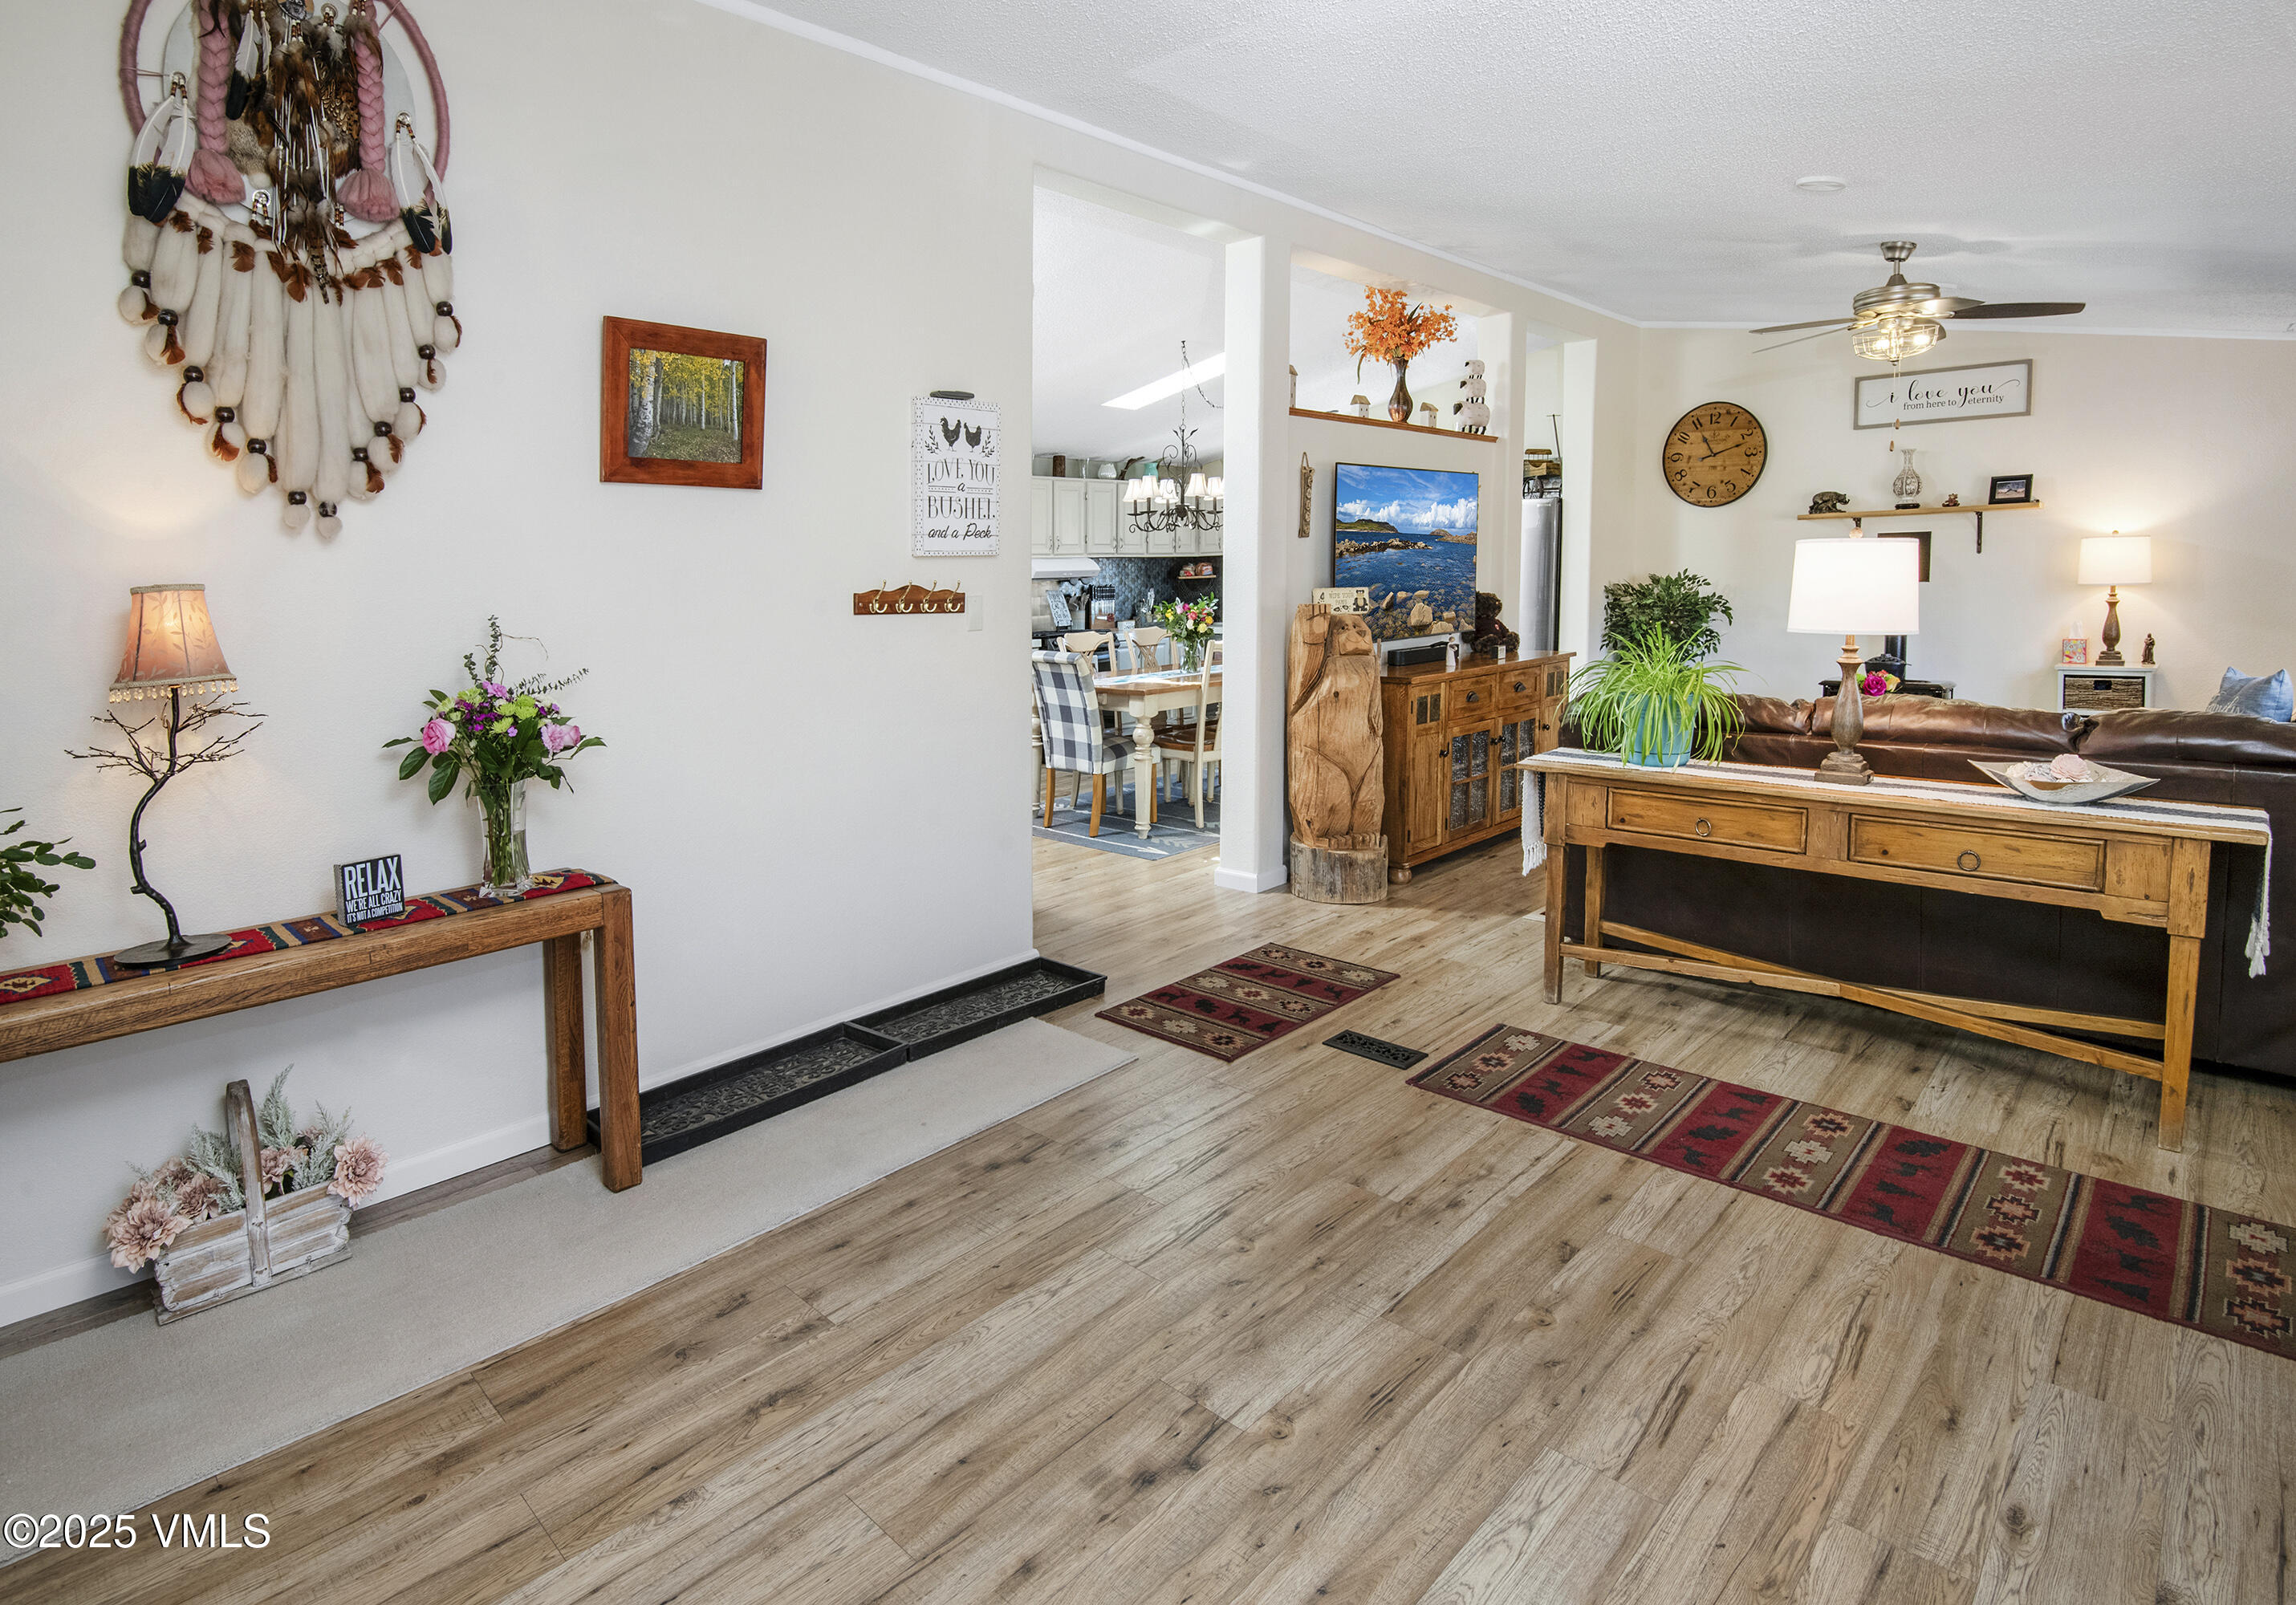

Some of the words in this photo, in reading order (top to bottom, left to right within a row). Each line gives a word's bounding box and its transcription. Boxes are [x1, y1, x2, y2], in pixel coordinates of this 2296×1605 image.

[1908, 379, 1948, 401] love
[1903, 402, 1924, 411] from
[1926, 400, 1946, 408] here
[1948, 399, 1957, 407] to
[1967, 394, 2005, 404] eternity
[1692, 417, 1703, 430] 11
[1709, 411, 1721, 425] 12
[1729, 416, 1738, 427] 1
[1677, 431, 1691, 445] 10
[1740, 429, 1753, 440] 2
[1670, 452, 1684, 463] 9
[1744, 447, 1758, 457] 3
[927, 457, 964, 484] LOVE
[969, 459, 995, 486] YOU
[1674, 469, 1688, 482] 8
[1740, 468, 1751, 479] 4
[957, 482, 966, 492] a
[1688, 481, 1701, 493] 7
[1706, 486, 1717, 498] 6
[1725, 480, 1737, 493] 5
[927, 495, 996, 520] BUSHEL
[928, 525, 949, 538] and
[951, 529, 959, 538] a
[963, 522, 992, 541] Peck
[343, 856, 401, 900] RELAX
[345, 897, 368, 913] WE'RE
[368, 894, 380, 908] ALL
[380, 889, 402, 905] CRAZY
[347, 912, 357, 924] IT'S
[356, 909, 367, 921] NOT
[367, 909, 372, 919] A
[372, 902, 403, 917] COMPETITION
